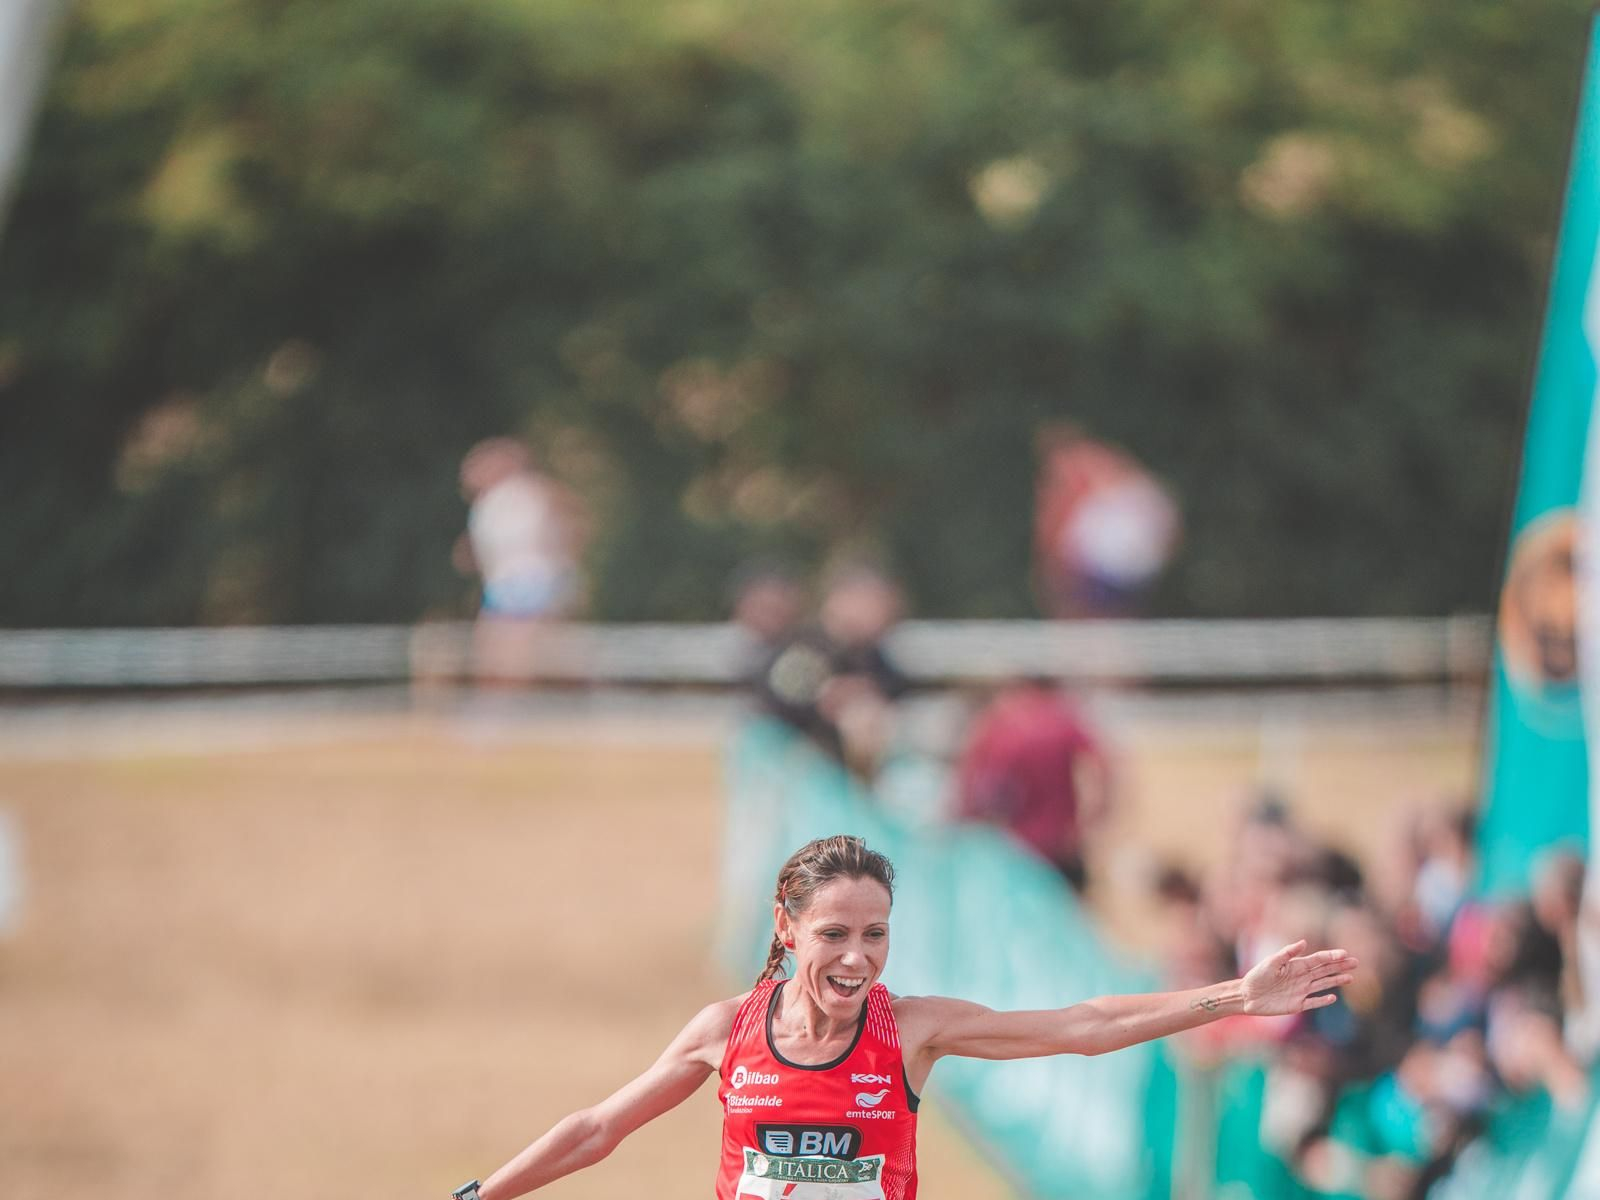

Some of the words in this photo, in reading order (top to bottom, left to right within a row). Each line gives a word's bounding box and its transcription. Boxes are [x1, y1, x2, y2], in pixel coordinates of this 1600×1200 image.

[733, 1068, 780, 1087] Bilbao
[846, 1110, 896, 1119] emteSPORT
[799, 1131, 852, 1155] BM
[778, 1160, 849, 1179] ITÁLICA
